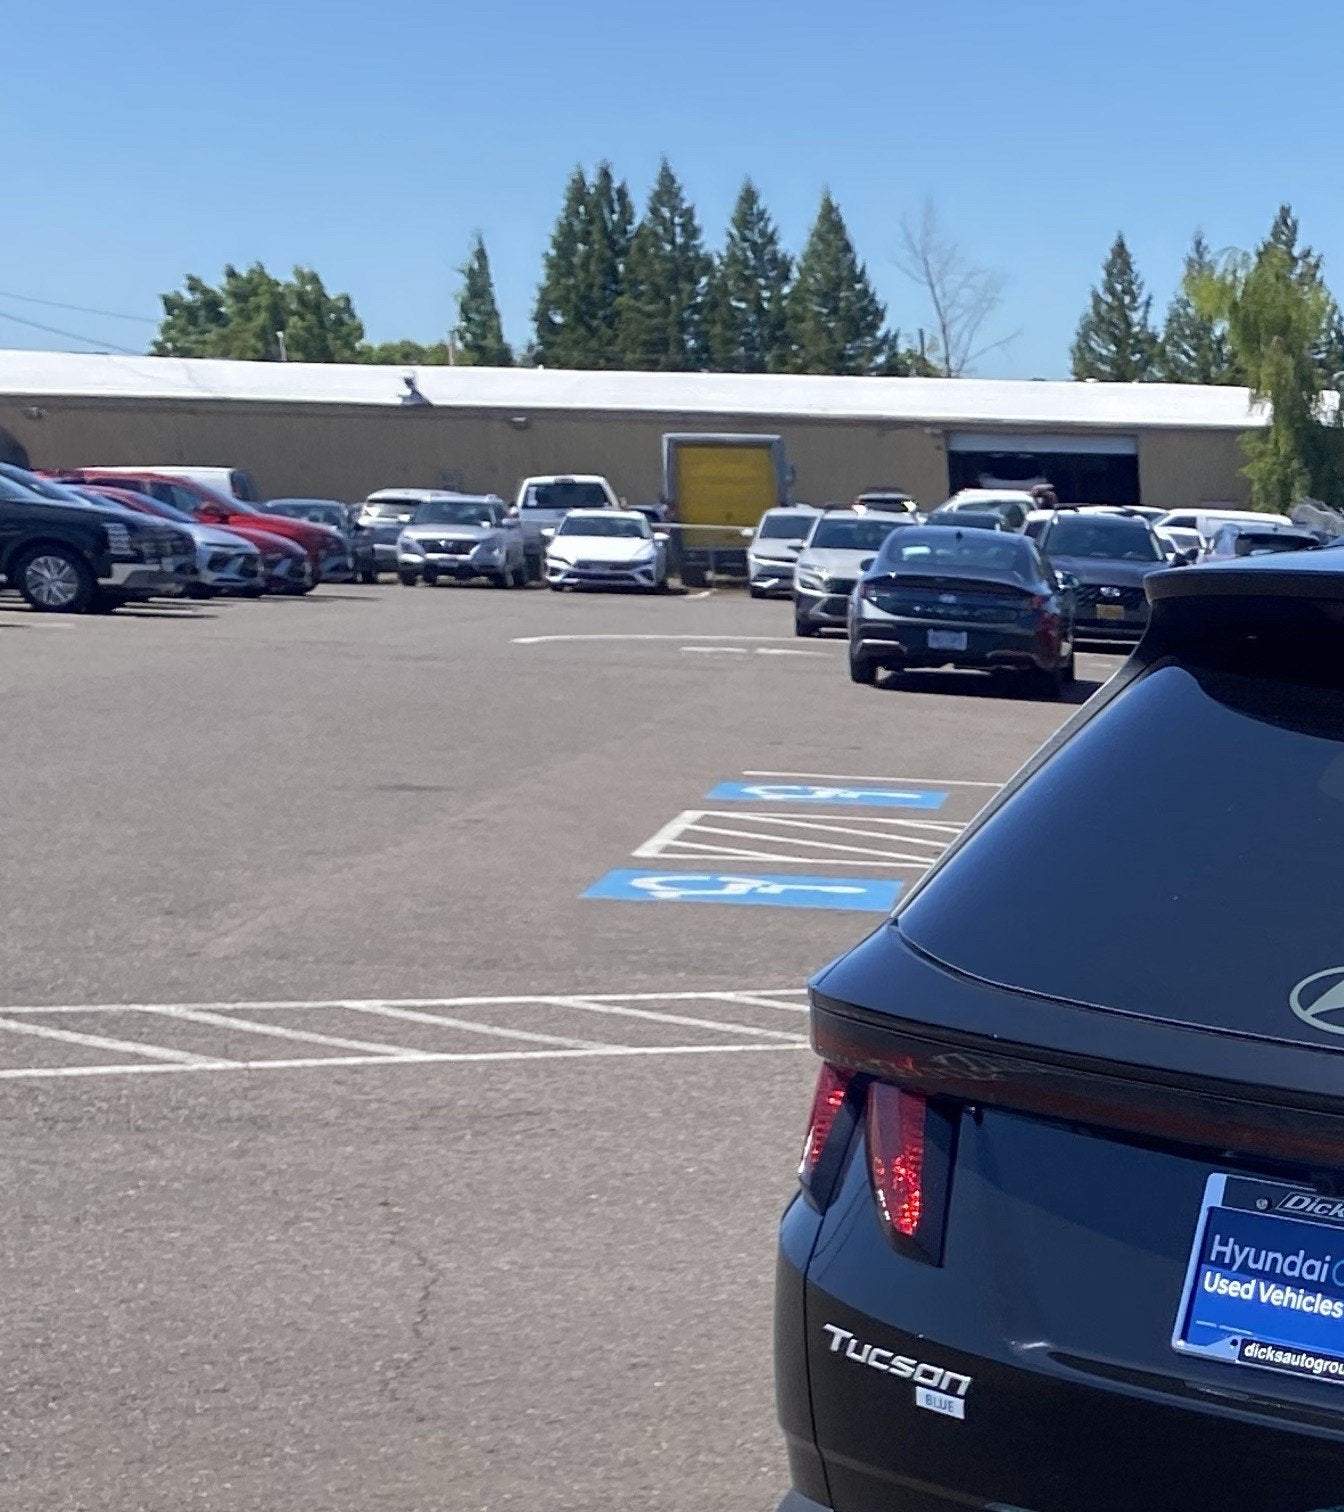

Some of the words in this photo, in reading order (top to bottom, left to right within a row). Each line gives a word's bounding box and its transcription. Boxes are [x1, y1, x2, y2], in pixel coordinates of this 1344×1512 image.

[1210, 1233, 1331, 1283] Hyundai
[1203, 1270, 1256, 1300] Used
[1259, 1281, 1344, 1319] Vehicles
[925, 1393, 954, 1413] BLUE
